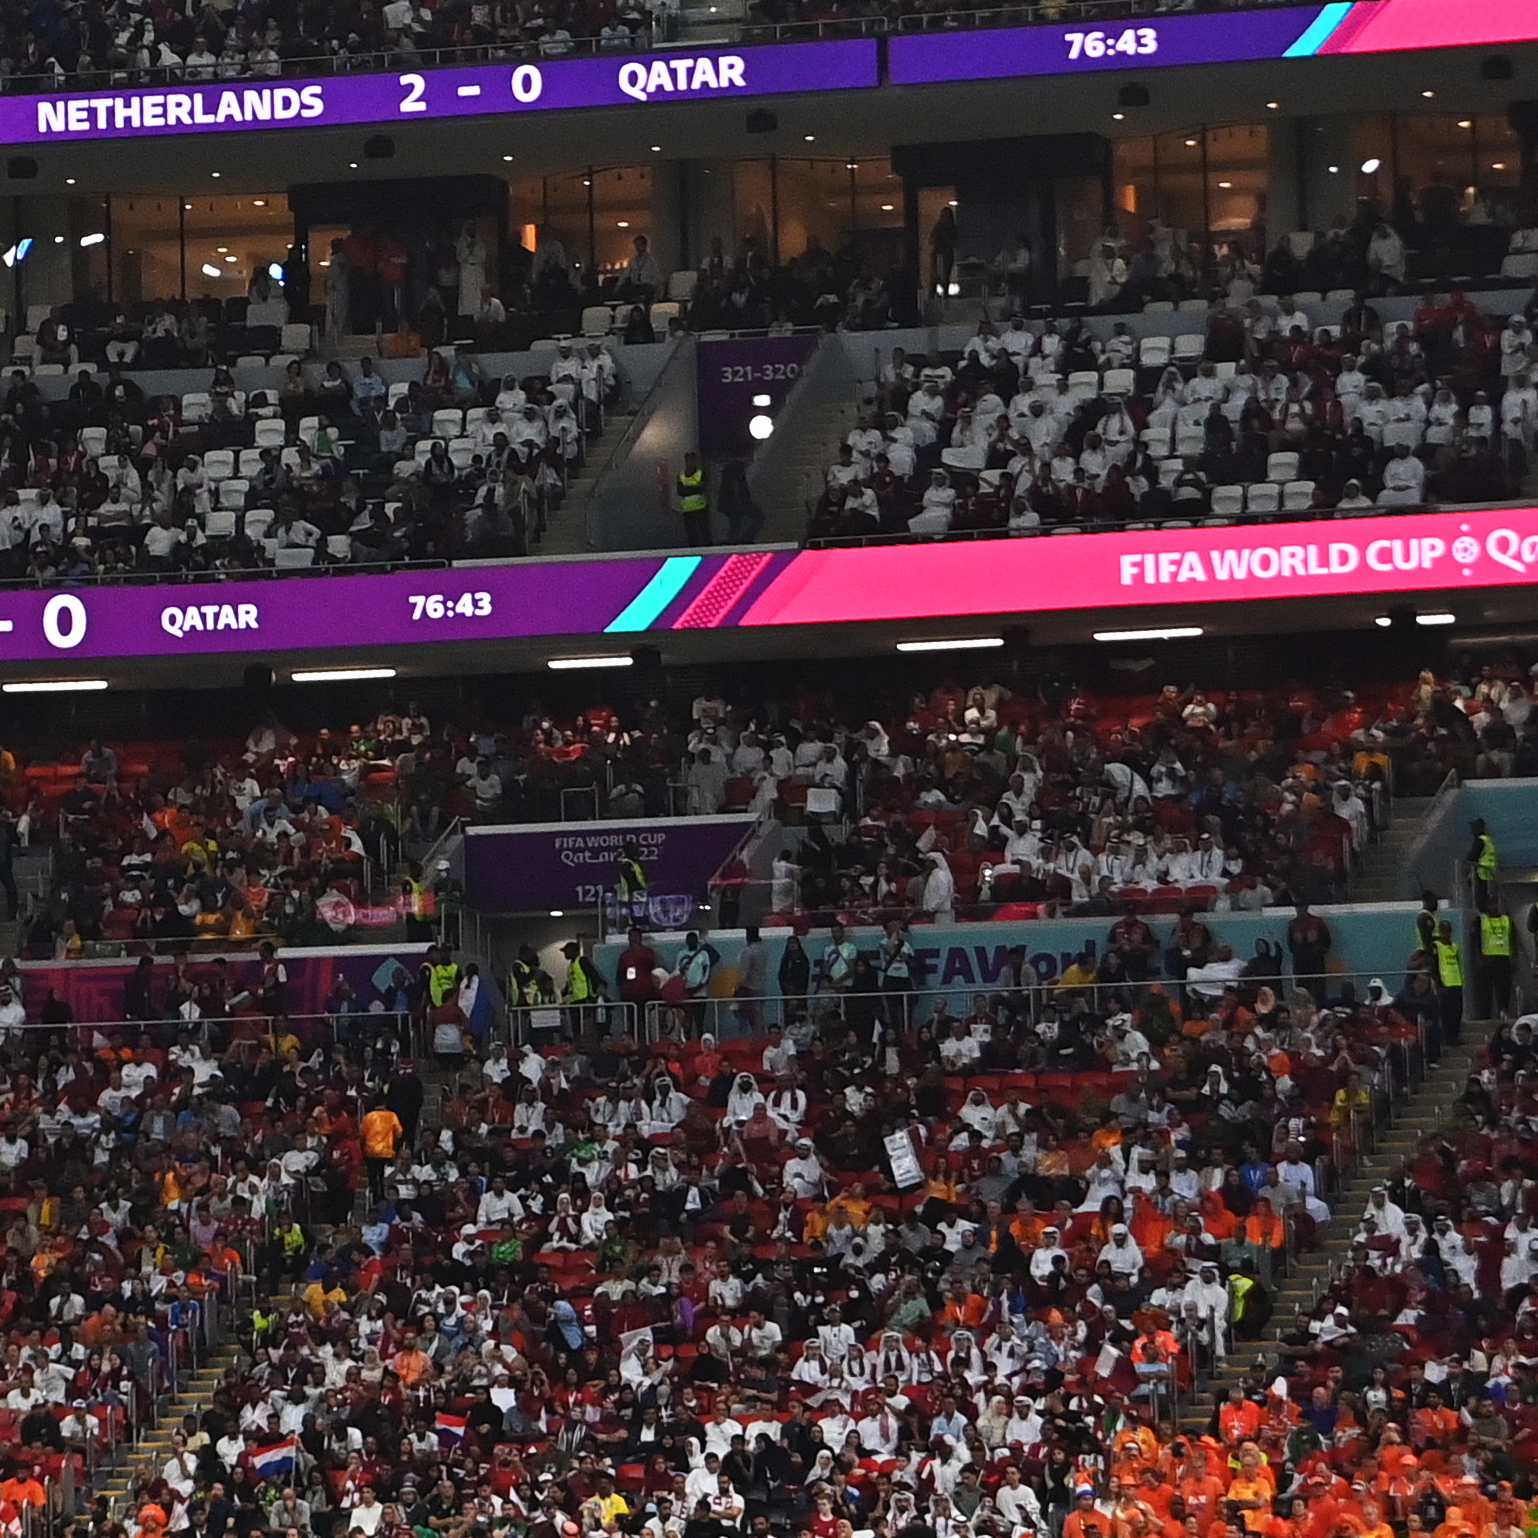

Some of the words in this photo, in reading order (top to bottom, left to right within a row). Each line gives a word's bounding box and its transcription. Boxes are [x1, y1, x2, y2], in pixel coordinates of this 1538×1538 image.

[1065, 28, 1157, 59] 76:43
[38, 86, 323, 132] NETHERLANDS
[400, 74, 426, 112] 2
[512, 65, 542, 102] 0
[619, 56, 746, 101] QATAR
[721, 363, 798, 383] 321-320
[1121, 552, 1206, 584] FIFA
[1211, 543, 1358, 580] WORLD
[1367, 538, 1444, 571] CUP
[43, 594, 86, 648] 0
[162, 604, 258, 637] QATAR
[409, 592, 492, 619] 76:43
[554, 837, 585, 849] FIFA
[639, 832, 666, 845] CUP
